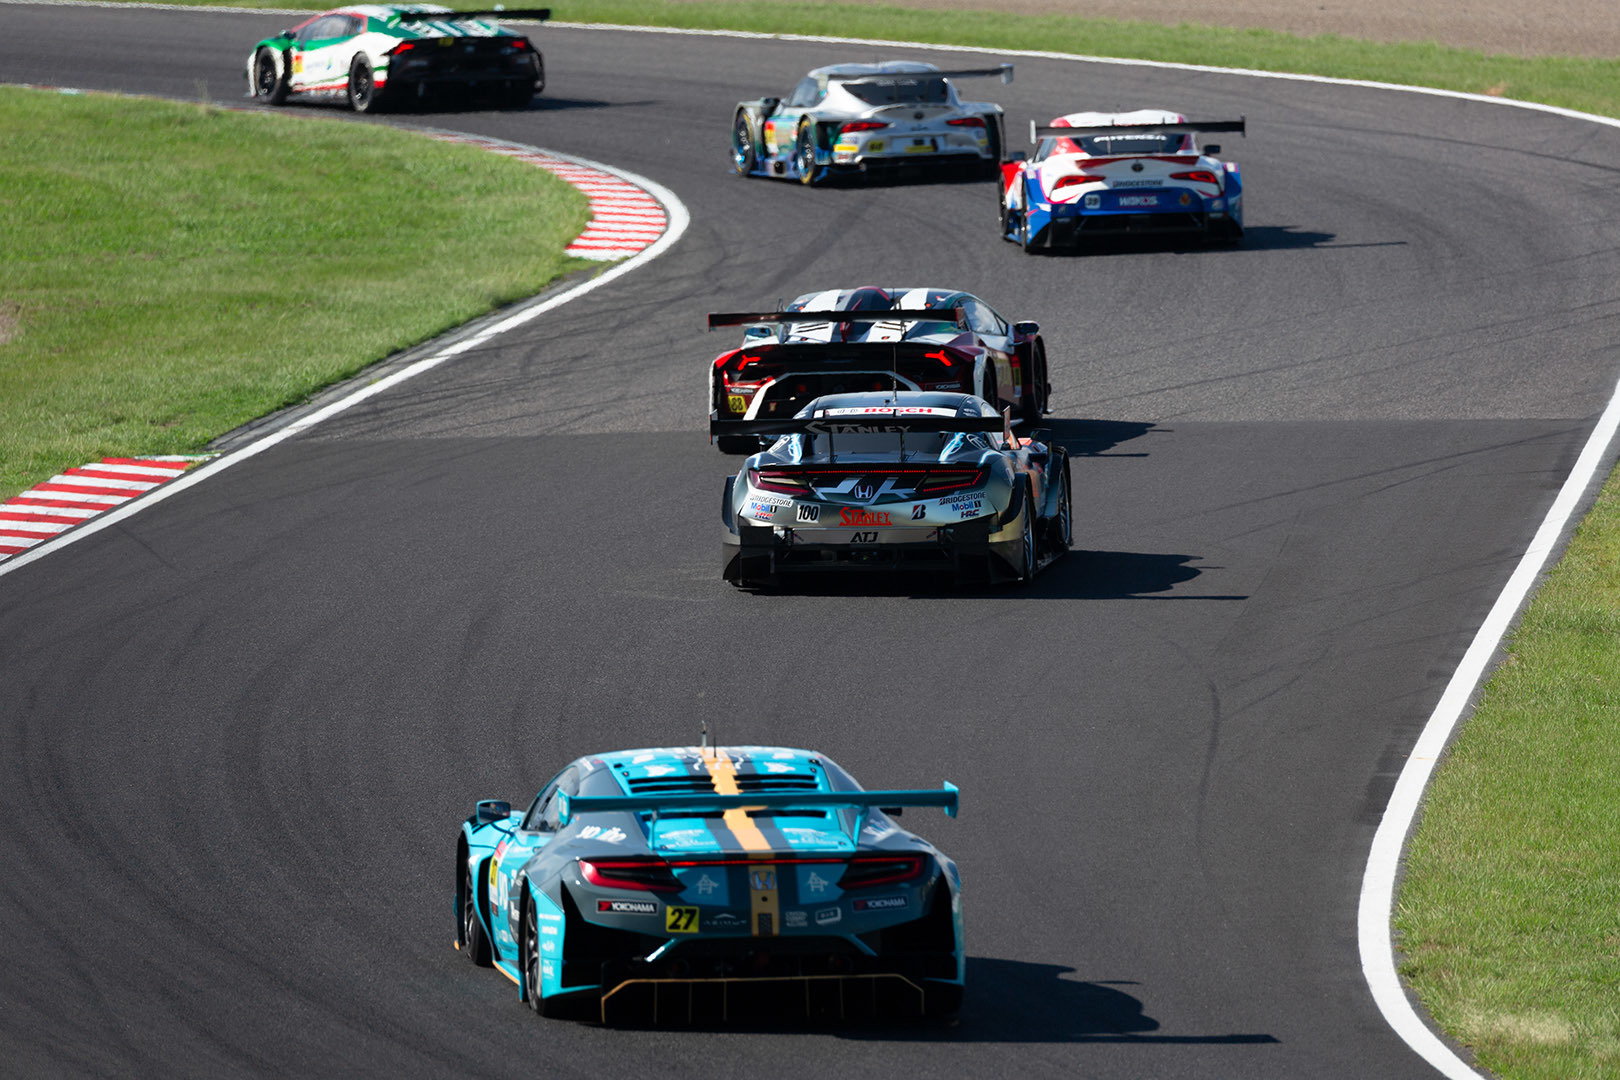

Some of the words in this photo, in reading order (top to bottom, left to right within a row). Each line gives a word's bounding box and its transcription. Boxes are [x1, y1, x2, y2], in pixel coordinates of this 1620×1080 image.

[805, 421, 911, 433] STANLEY
[750, 494, 791, 506] BRIDGESTONE
[939, 492, 986, 505] BRIDGESTONE
[751, 502, 770, 512] Mobil
[952, 502, 973, 511] Mobil
[799, 505, 819, 520] 100
[839, 506, 893, 526] STANLEY
[961, 510, 979, 518] HRC
[851, 532, 878, 542] ATJ
[611, 902, 654, 912] YOKOHAMA
[867, 898, 905, 908] YOKOHAMA
[669, 908, 697, 930] 27
